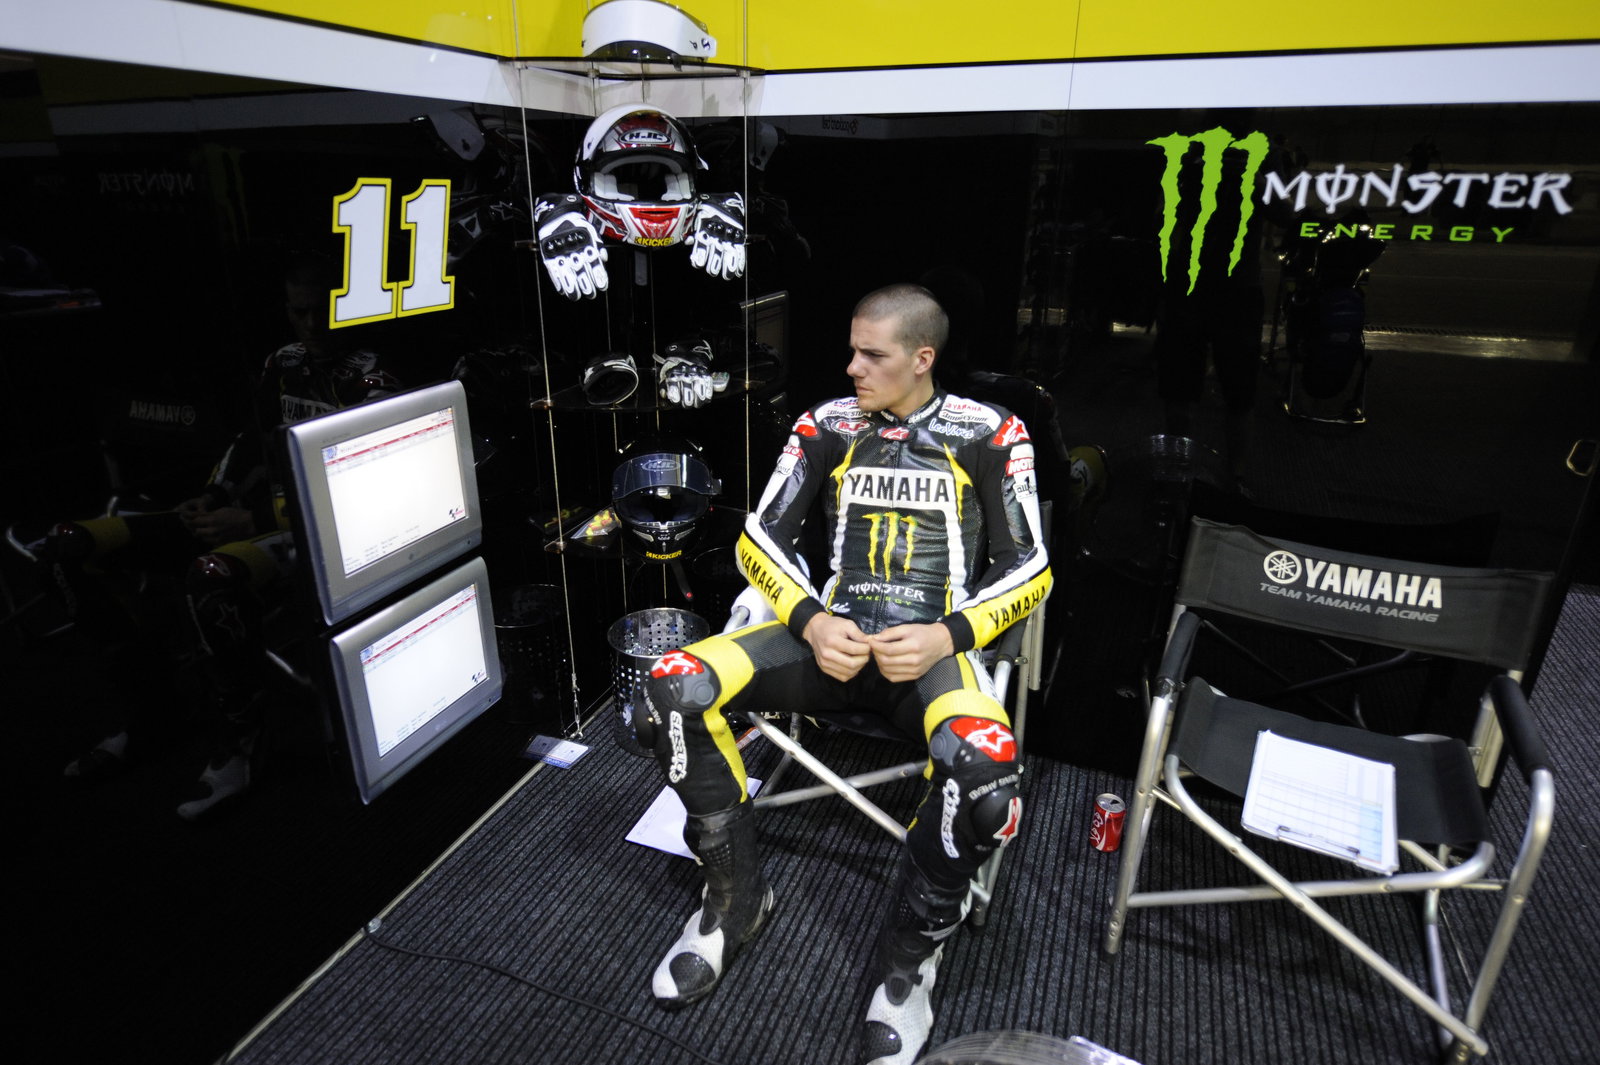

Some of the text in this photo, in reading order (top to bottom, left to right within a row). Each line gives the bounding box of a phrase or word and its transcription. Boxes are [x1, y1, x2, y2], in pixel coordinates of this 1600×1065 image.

[628, 131, 664, 141] HJC
[640, 236, 673, 247] KICKER
[1300, 222, 1513, 243] ENERGY
[329, 177, 455, 329] 11
[850, 473, 950, 503] YAMAHA
[651, 549, 682, 560] KICKER
[740, 548, 785, 605] YAMAHA
[1304, 558, 1443, 609] YAMAHA
[857, 595, 911, 606] ENERGY
[989, 584, 1047, 630] YAMAHA
[1259, 582, 1439, 622] TEAM YAMAHA RACING
